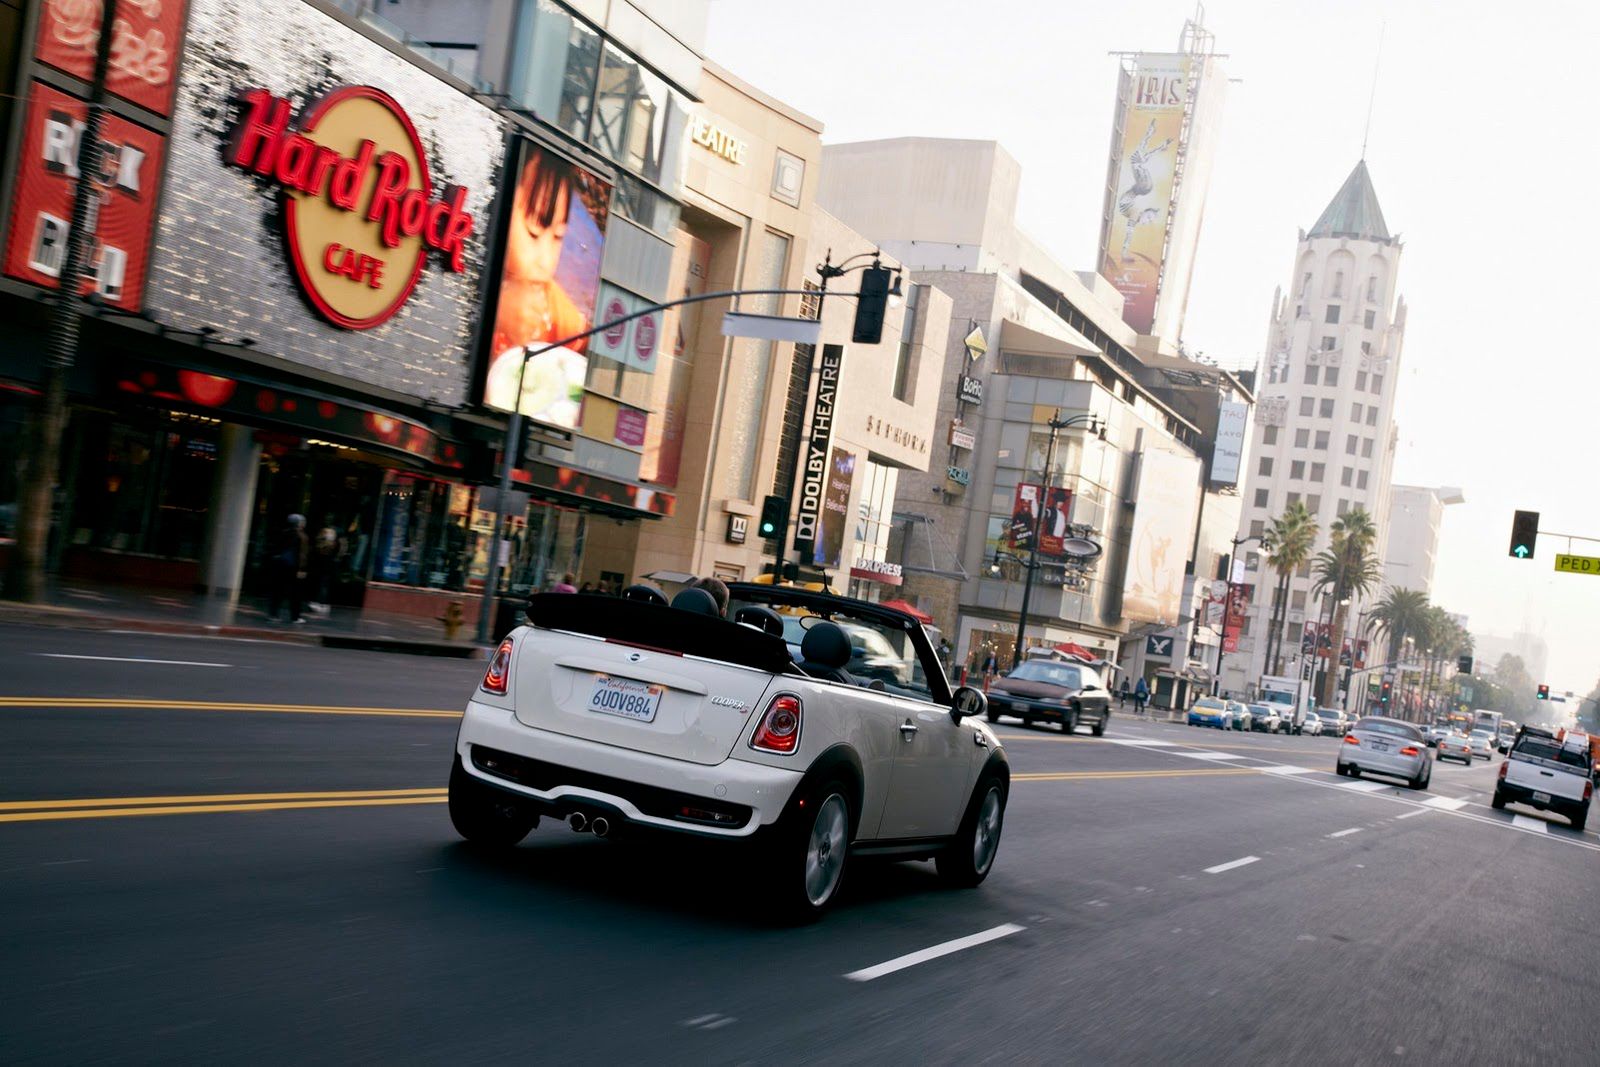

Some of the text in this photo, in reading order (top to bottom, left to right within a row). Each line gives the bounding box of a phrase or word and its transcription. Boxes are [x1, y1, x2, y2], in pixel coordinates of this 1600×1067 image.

[1136, 76, 1182, 105] IRIS
[235, 88, 376, 213] Hard
[367, 150, 475, 274] Rock
[323, 242, 386, 290] CAFE
[803, 355, 840, 511] DOLBY THEATRE
[856, 558, 902, 577] EXPRESS
[1561, 557, 1591, 571] PED
[607, 679, 645, 692] California
[711, 695, 744, 710] COOPER
